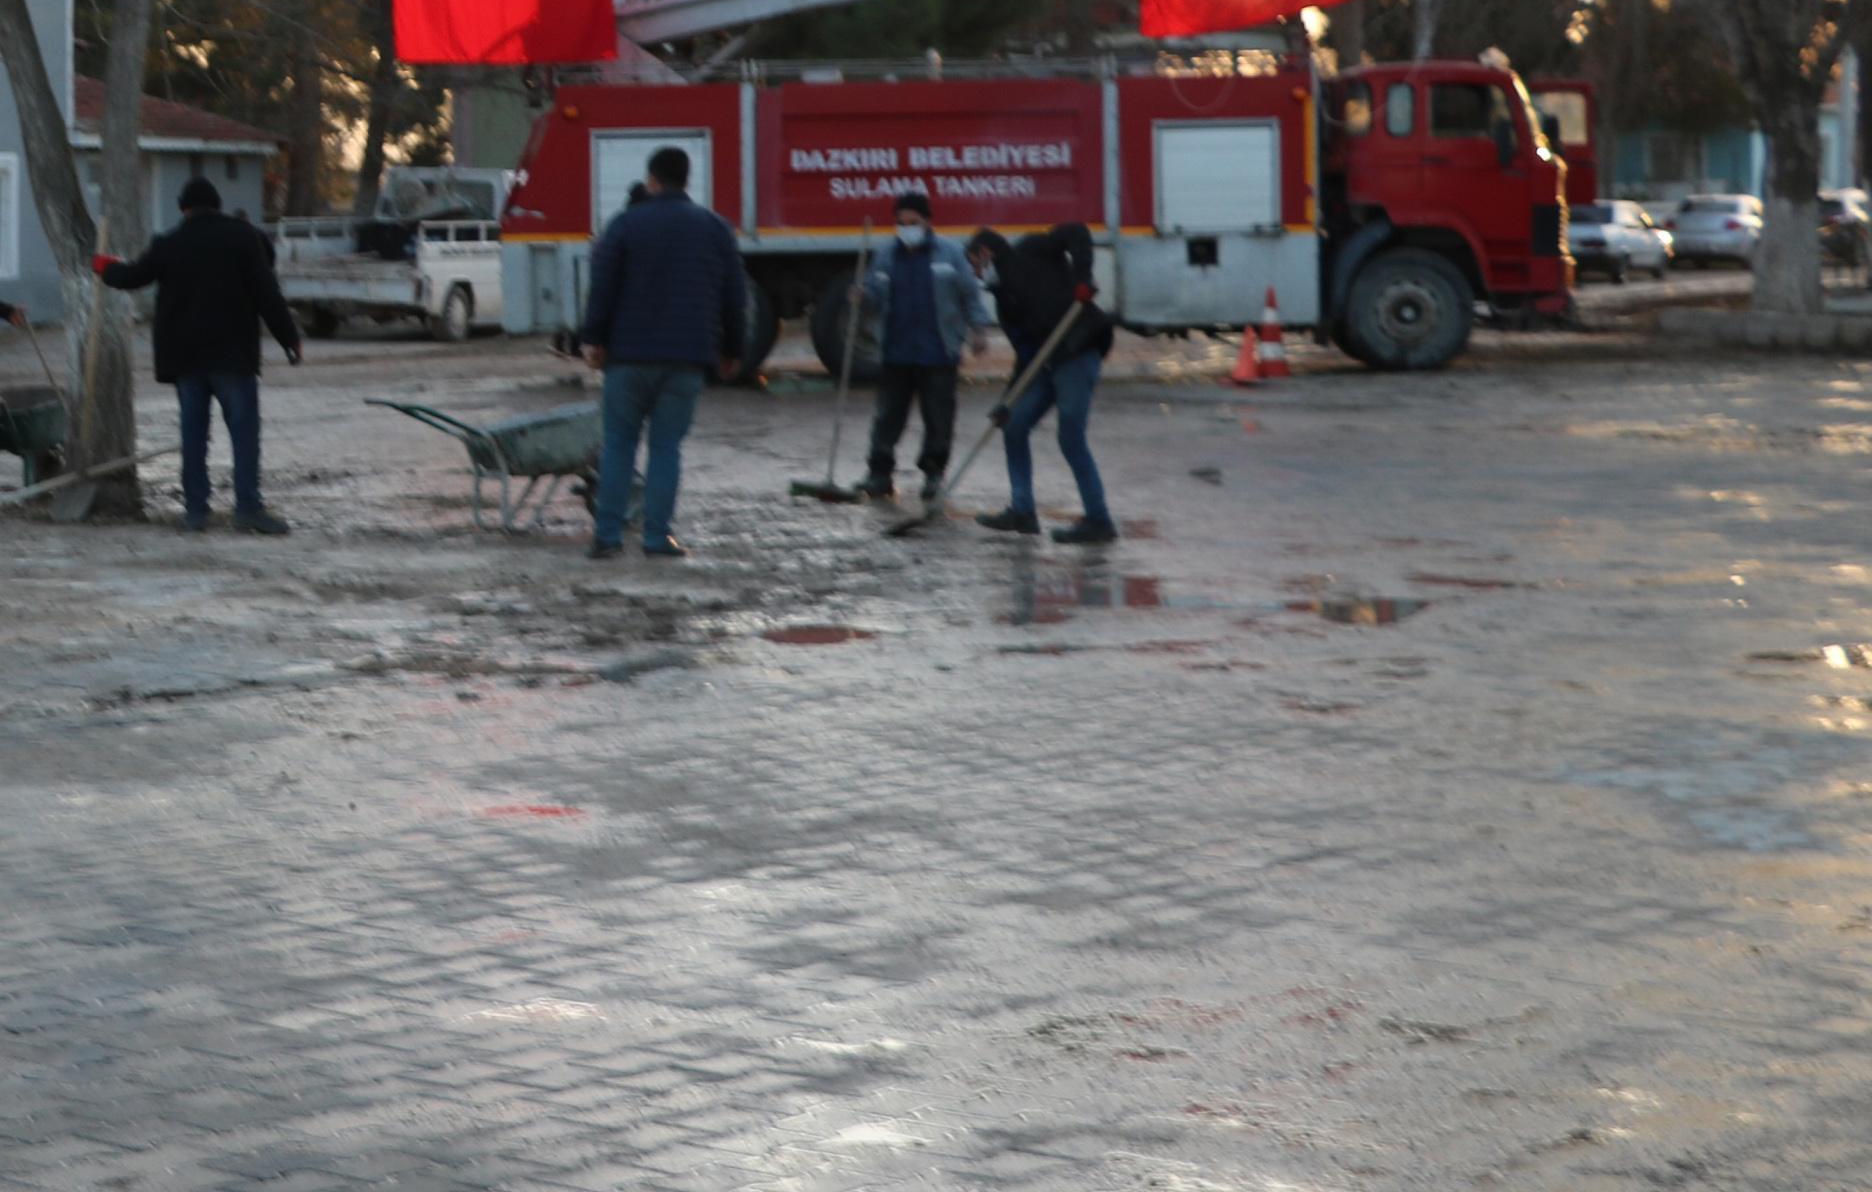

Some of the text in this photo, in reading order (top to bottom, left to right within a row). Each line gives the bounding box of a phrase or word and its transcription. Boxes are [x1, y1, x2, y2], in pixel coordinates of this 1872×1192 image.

[791, 143, 1071, 170] DAZKIRI BELEDİYESİ
[830, 177, 928, 199] SULAMA
